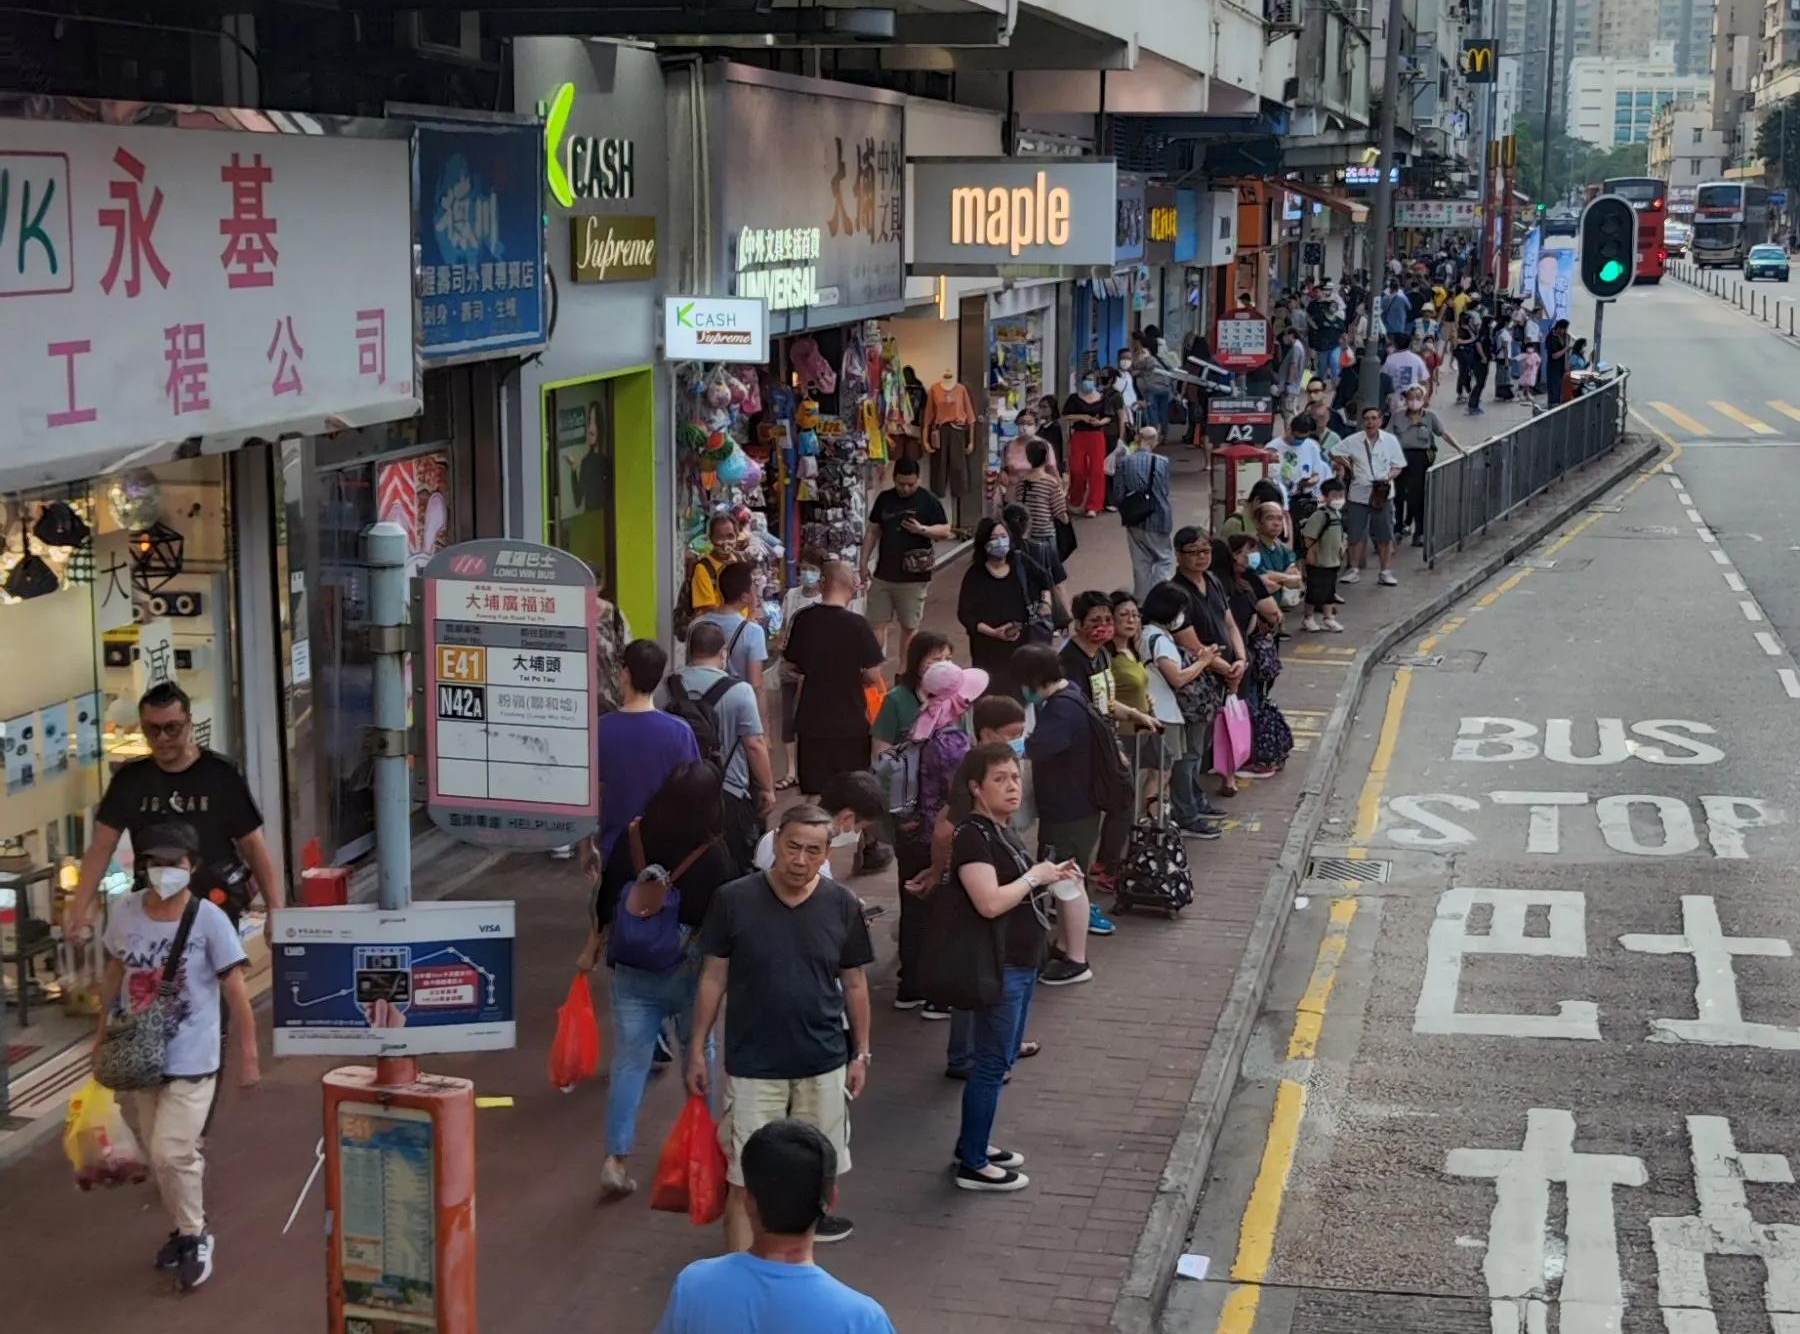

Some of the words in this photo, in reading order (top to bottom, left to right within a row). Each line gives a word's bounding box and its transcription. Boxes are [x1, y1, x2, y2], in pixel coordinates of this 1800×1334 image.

[98, 146, 279, 299] 永基
[951, 171, 1070, 256] maple
[577, 215, 654, 281] Supreme
[699, 331, 751, 345] Supreme
[47, 308, 387, 429] 工程公司
[1226, 424, 1253, 441] A2
[493, 568, 518, 577] LONG
[537, 570, 556, 580] BUS
[465, 593, 556, 614] 大埔廣福道
[443, 650, 480, 680] E41
[512, 654, 562, 673] 大埔頭
[1451, 716, 1726, 766] BUS
[1386, 791, 1790, 859] STOP
[479, 924, 502, 934] VISA
[1413, 887, 1800, 1050] 巴士
